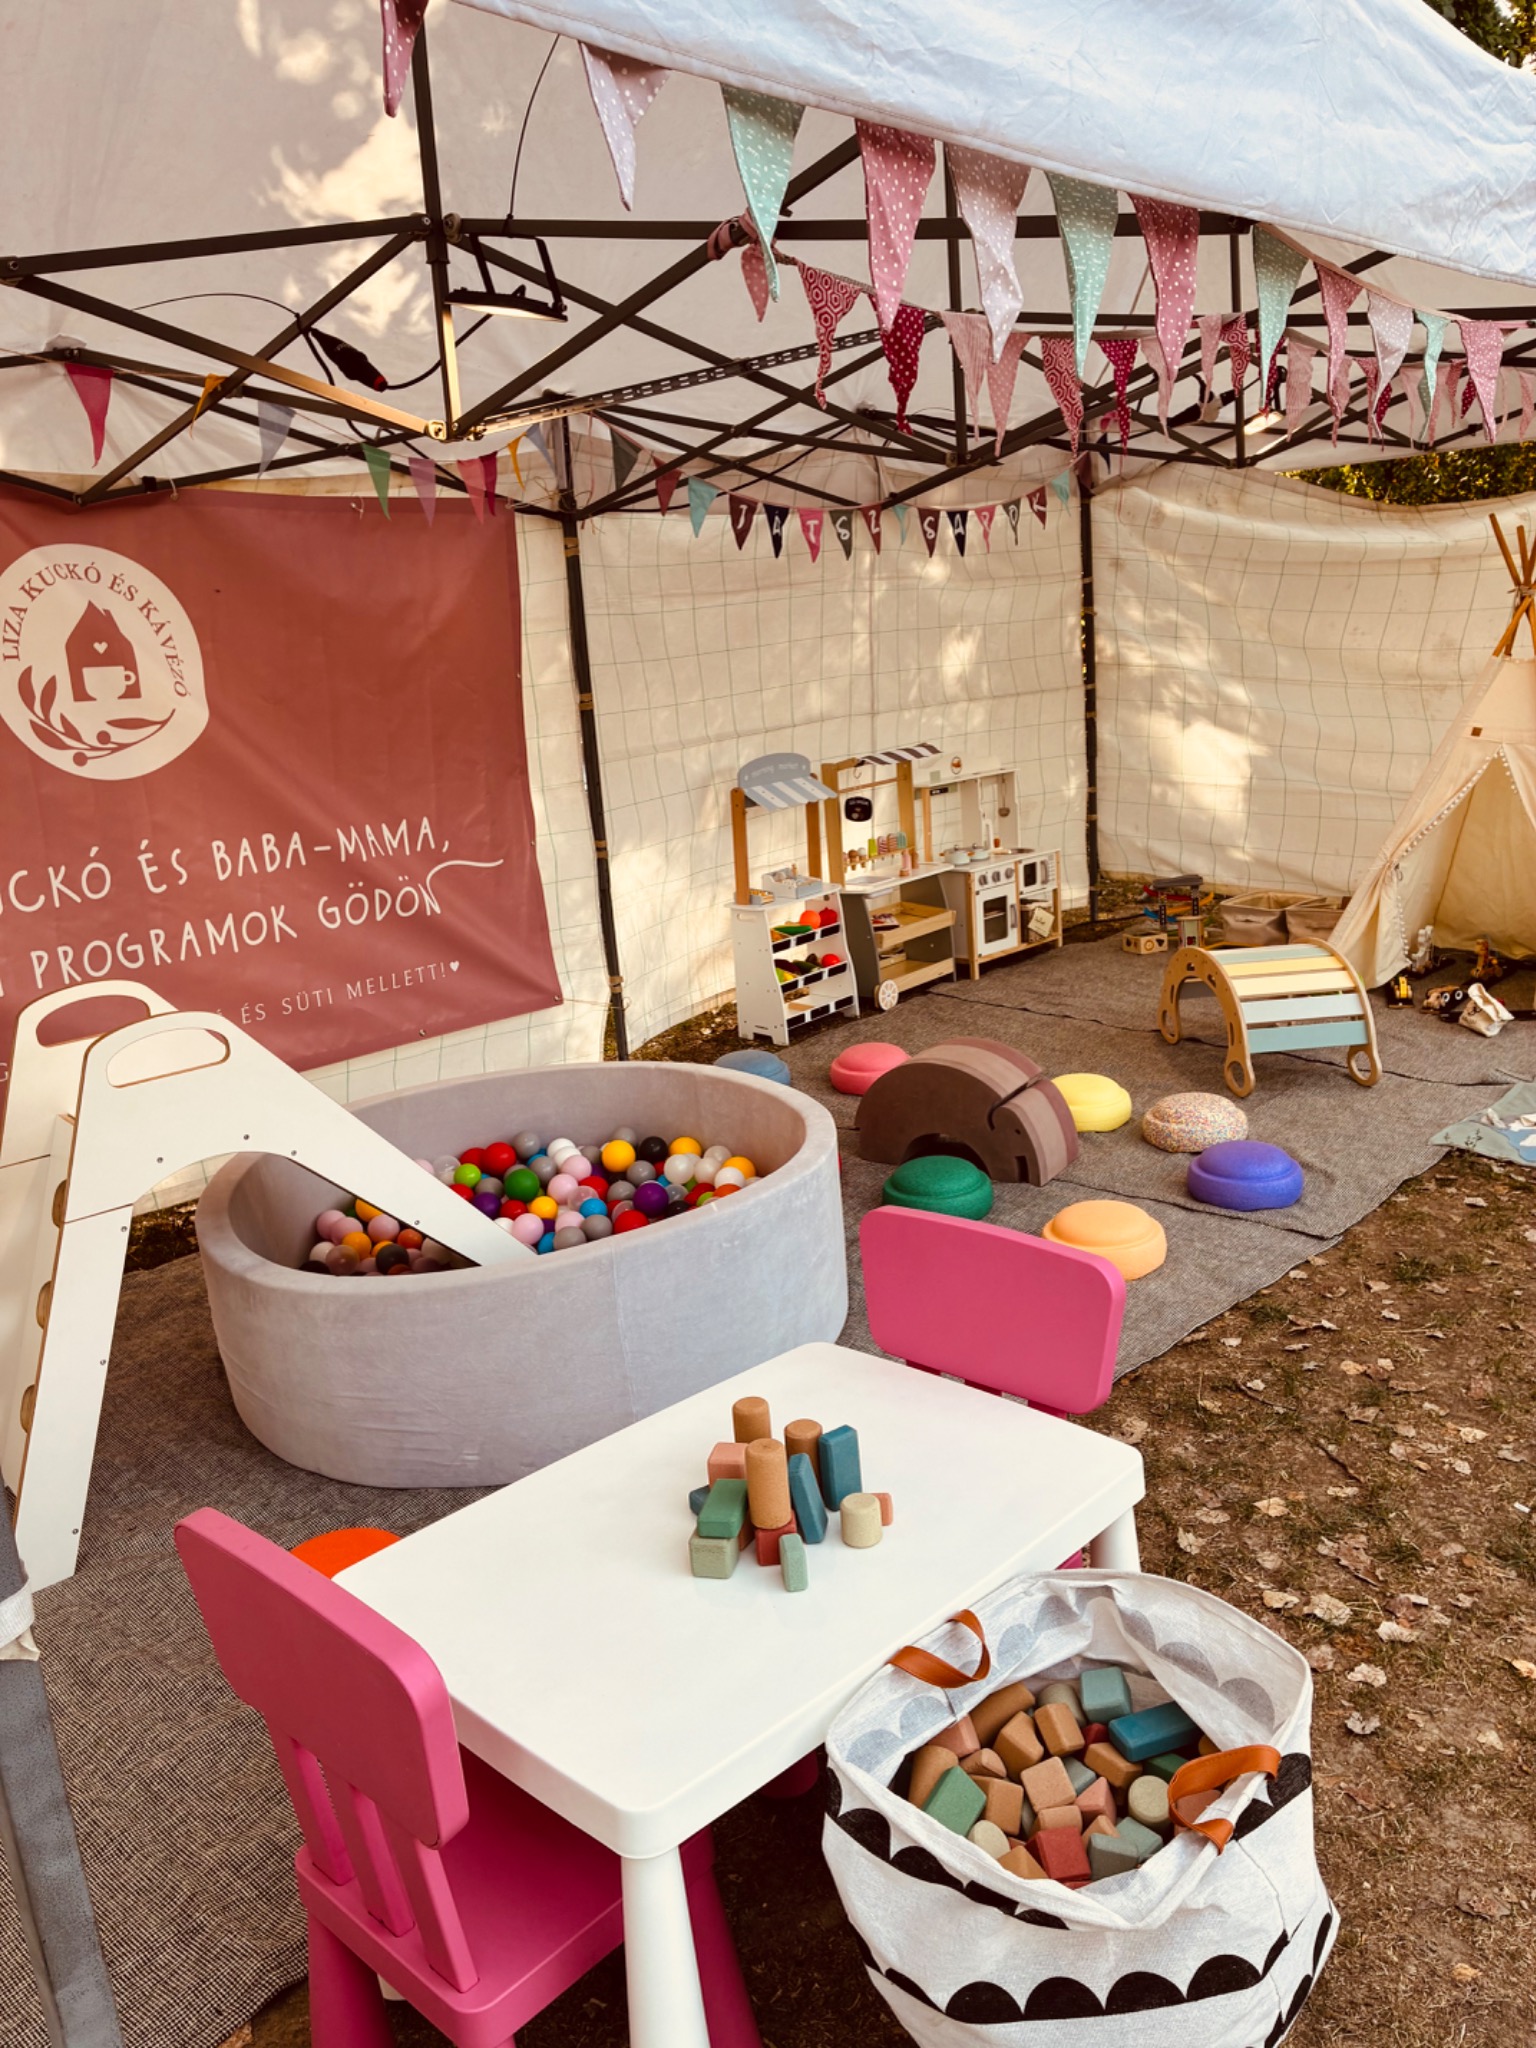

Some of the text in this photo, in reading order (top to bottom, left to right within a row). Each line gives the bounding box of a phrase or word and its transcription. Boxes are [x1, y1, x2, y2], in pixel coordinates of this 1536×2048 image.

[922, 492, 1047, 540] SAROK
[3, 562, 191, 698] LIZA KUCKÓ ÉS KÁVÉZÓ
[0, 816, 449, 915] CKÓ ÉS BABA-MAMA,
[30, 859, 504, 989] PROGRAMOK GÖDÖN
[241, 962, 446, 1025] ÉS SÜTI MELLETT!
